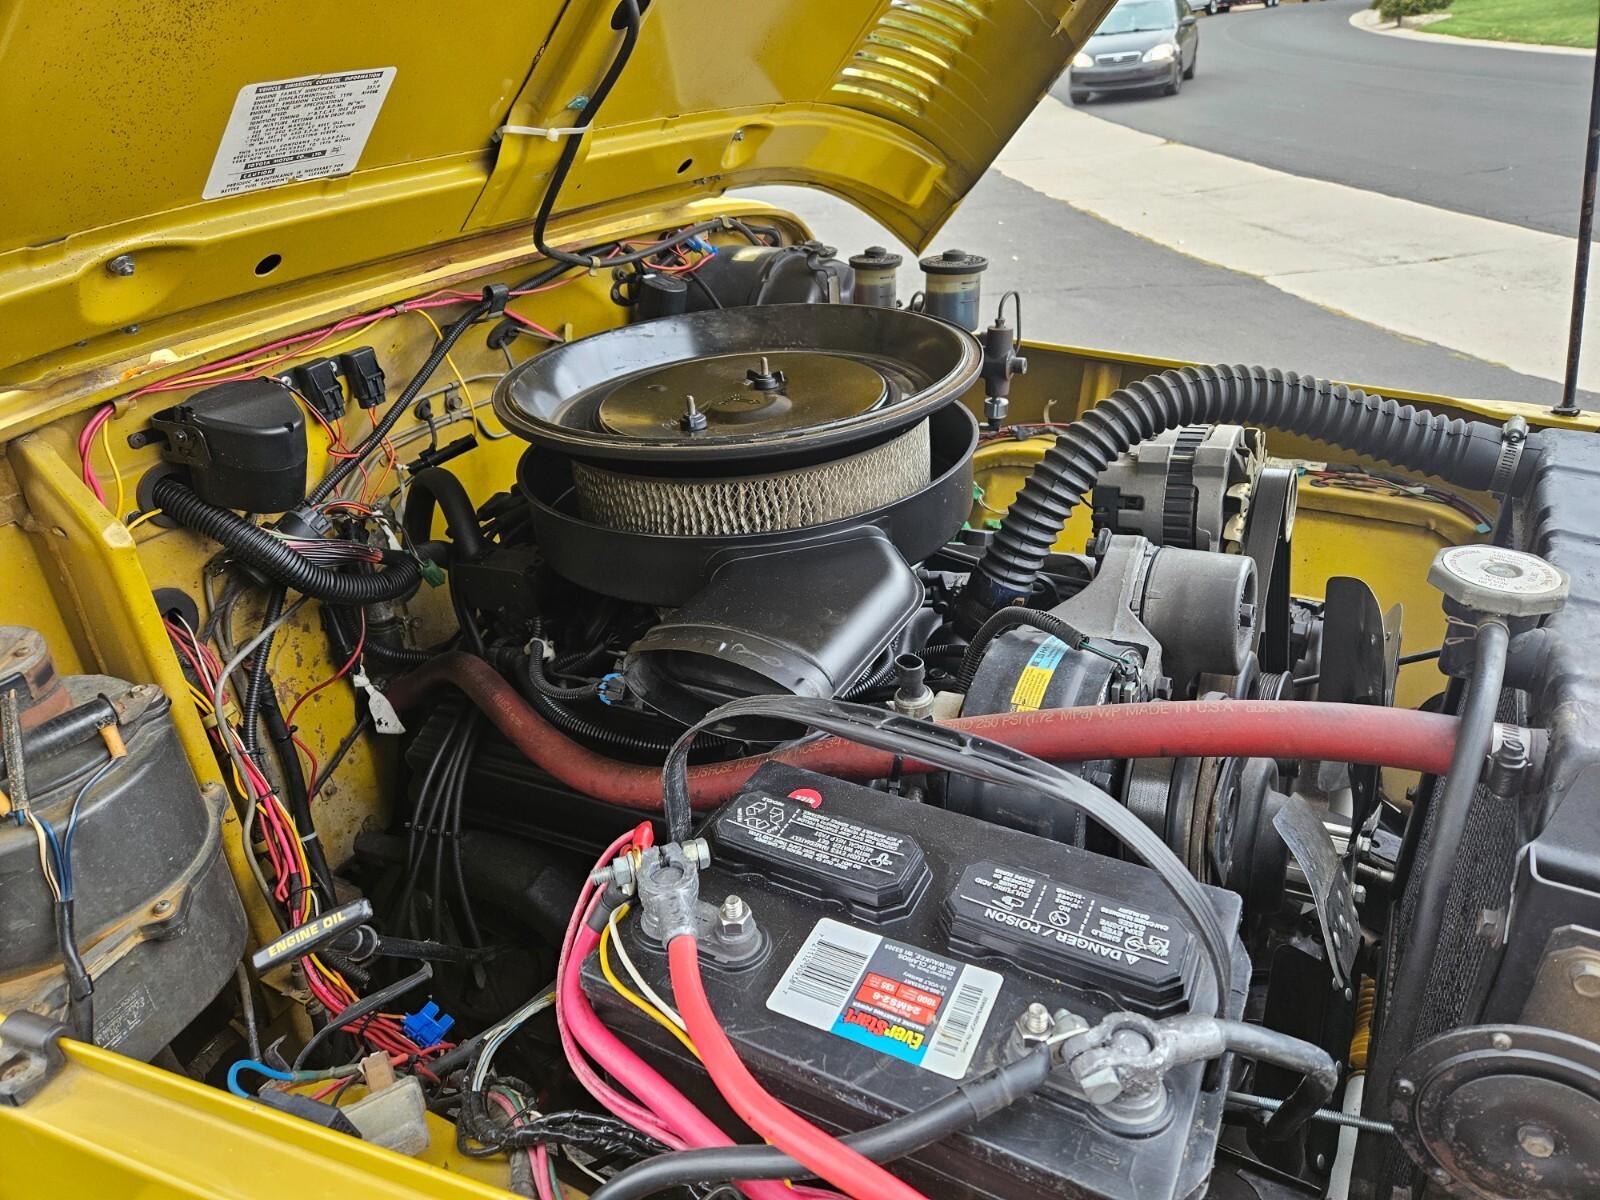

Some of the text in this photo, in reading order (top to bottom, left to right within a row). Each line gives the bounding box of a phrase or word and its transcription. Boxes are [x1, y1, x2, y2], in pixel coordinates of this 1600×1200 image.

[257, 85, 282, 93] VEHICLE
[315, 77, 341, 85] CONTROL
[246, 159, 272, 169] TOYOTA
[272, 156, 295, 164] MOTOR
[242, 169, 273, 179] CAUTION
[976, 718, 998, 729] 250
[1002, 714, 1022, 726] PSI
[1025, 712, 1054, 727] (1.72
[1060, 709, 1092, 724] MPa)
[1097, 706, 1121, 717] WP
[1126, 704, 1169, 716] MADE
[1175, 703, 1191, 714] IN
[972, 877, 1031, 899] SULFURIC ACID
[1057, 904, 1071, 912] NO
[985, 908, 1041, 934] POISON
[268, 911, 346, 957] ENGINE OIL
[883, 943, 905, 954] 53209
[1055, 931, 1122, 961] DANGER
[896, 953, 928, 968] CLARIOS
[912, 952, 958, 972] MILWAUKEE,
[901, 970, 925, 983] Battery
[936, 967, 955, 977] DIST.
[879, 981, 897, 993] 135
[872, 992, 922, 1014] 24MS2-6
[915, 994, 938, 1007] 1000
[851, 1001, 927, 1032] MARINE STARTING POWER
[842, 1007, 925, 1050] EverStart
